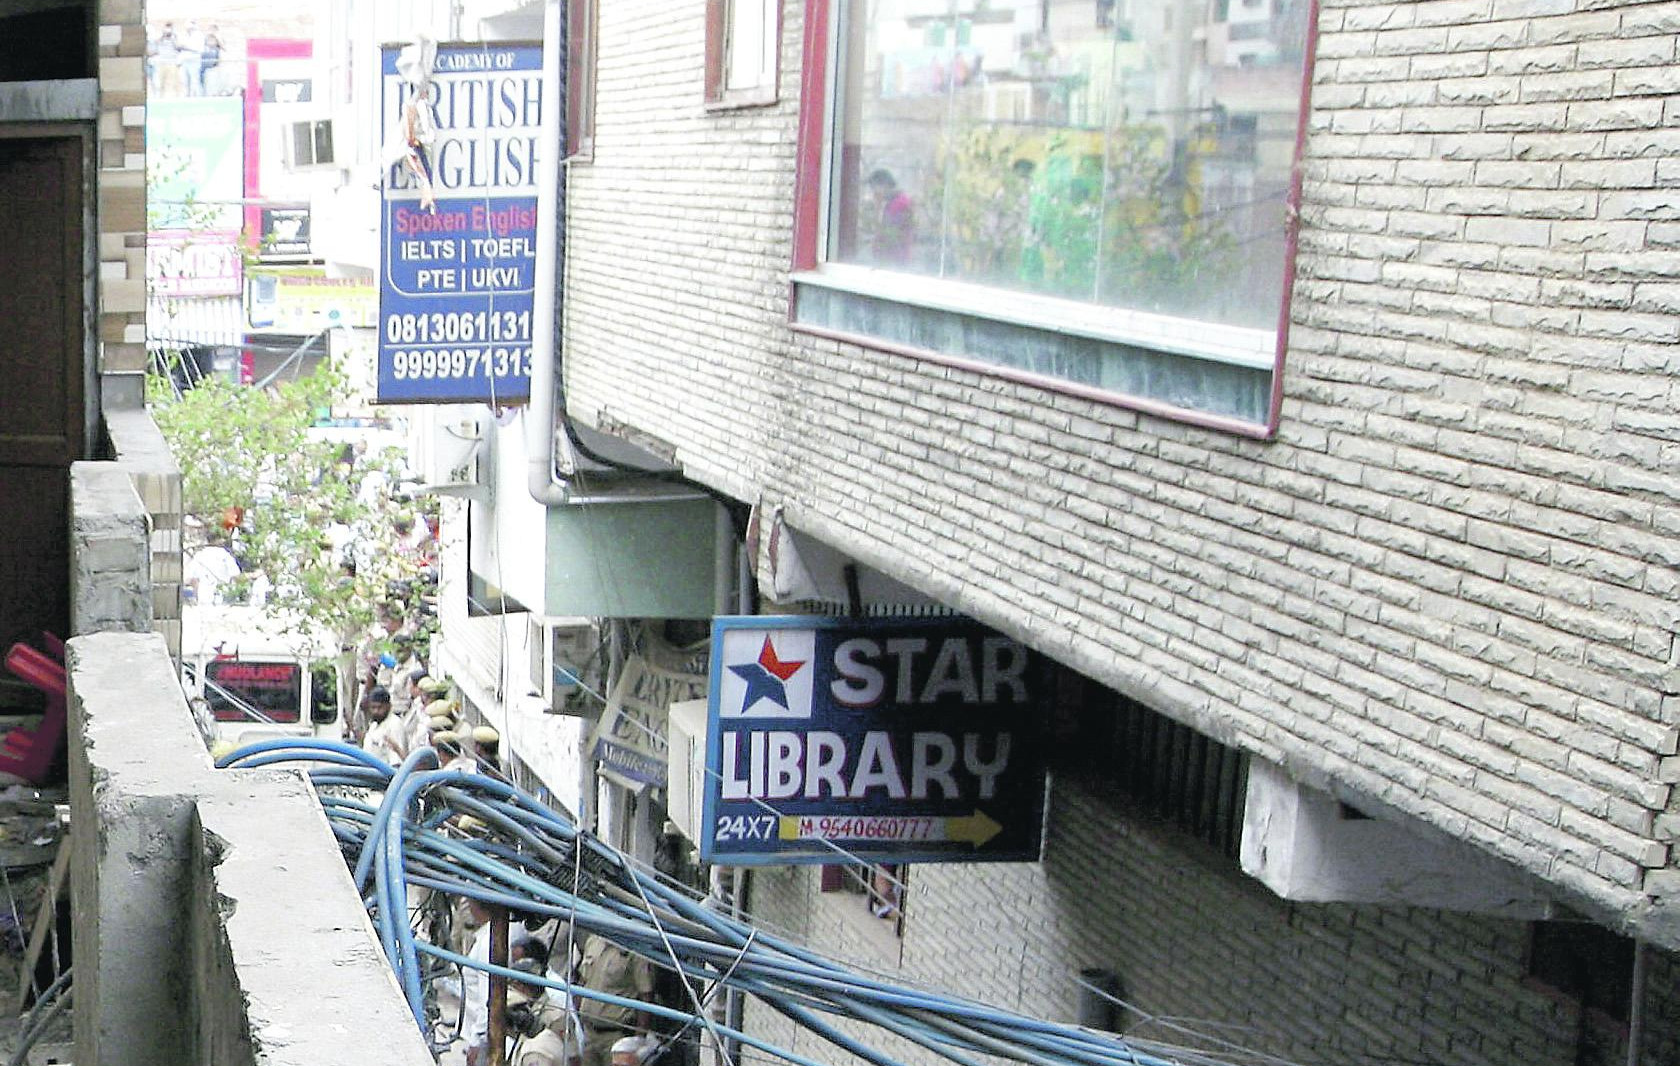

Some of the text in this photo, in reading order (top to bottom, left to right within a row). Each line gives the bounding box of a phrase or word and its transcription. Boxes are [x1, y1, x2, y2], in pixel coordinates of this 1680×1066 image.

[434, 52, 515, 70] CADEMY OF
[396, 206, 467, 237] Spoken
[401, 238, 535, 260] IELTS TOEFL
[418, 267, 519, 289] PTE UKVI
[830, 636, 1029, 704] STAR
[721, 730, 1012, 800] LIBRARY
[716, 816, 775, 841] 24X7
[820, 816, 932, 839] 9540660777
